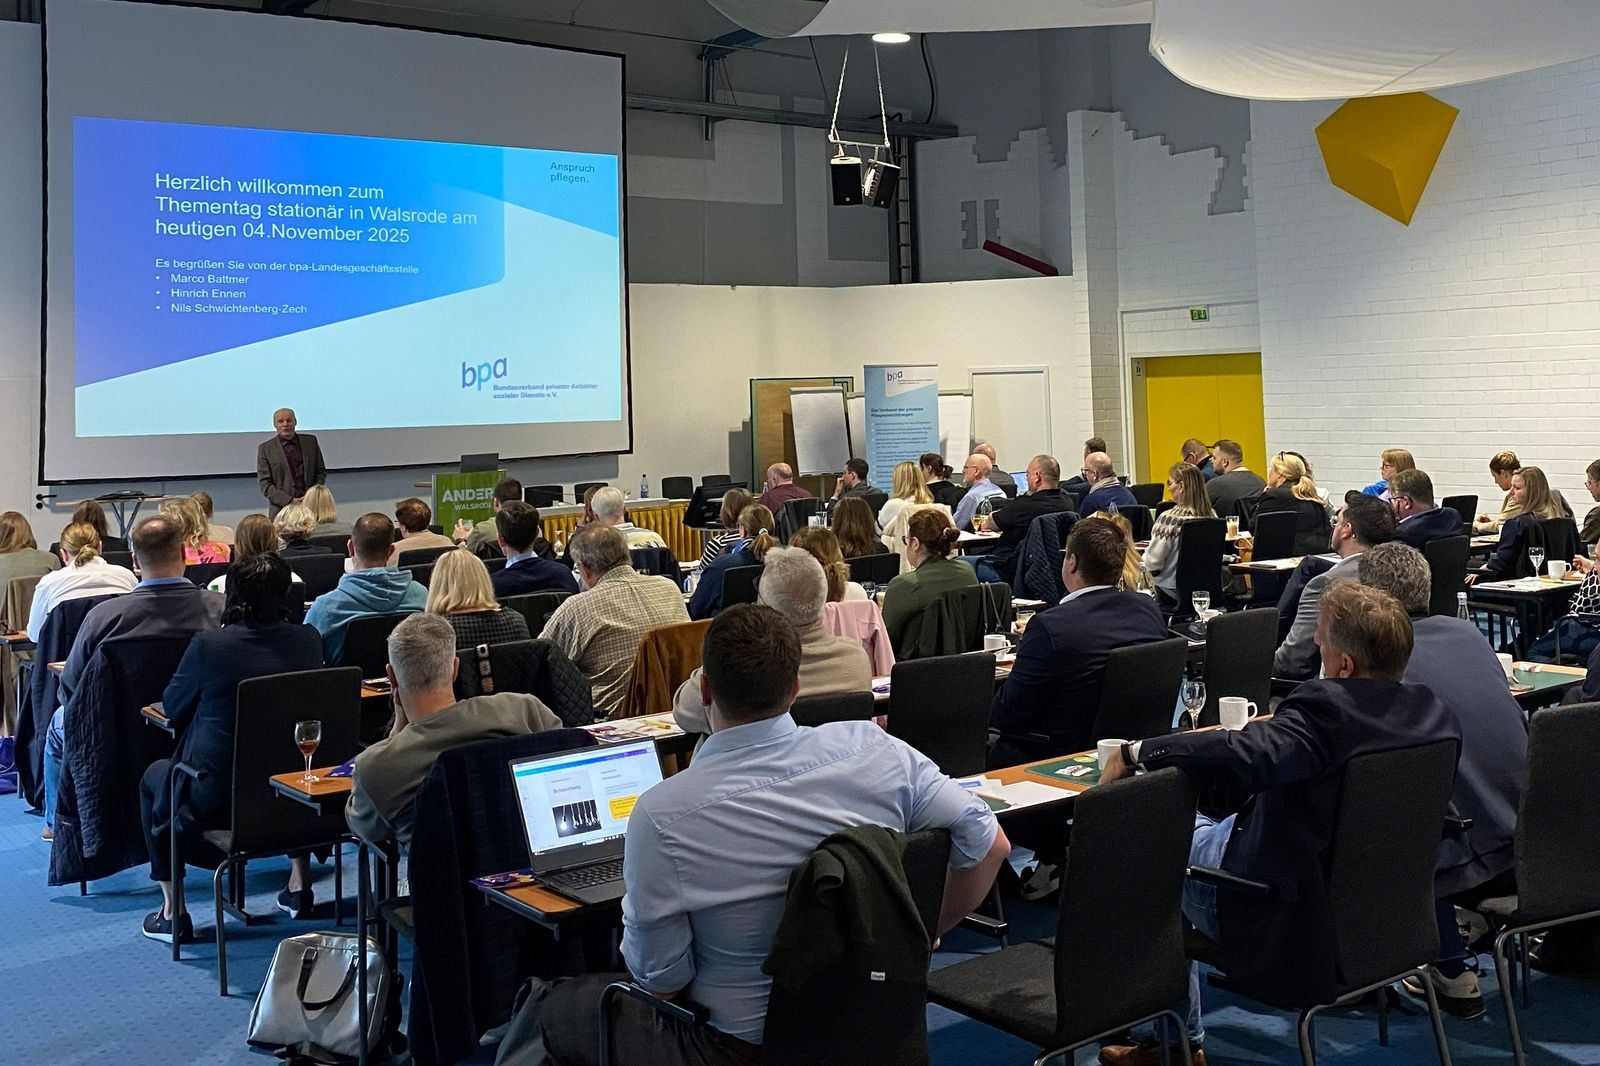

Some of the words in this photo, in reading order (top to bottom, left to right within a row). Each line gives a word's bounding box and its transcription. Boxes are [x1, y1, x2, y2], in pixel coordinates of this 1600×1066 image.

[550, 161, 595, 173] Anspruch
[550, 172, 589, 184] pflegen.
[155, 172, 232, 192] Herzlich
[237, 178, 343, 198] willkommen
[348, 186, 384, 199] zum
[155, 196, 262, 219] Thementag
[267, 203, 344, 219] stationär
[350, 205, 364, 220] in
[369, 206, 447, 224] Walsrode
[452, 213, 477, 225] am
[155, 219, 236, 240] heutigen
[243, 223, 363, 241] 04.November
[368, 227, 410, 243] 2025
[155, 259, 170, 268] Es
[173, 259, 225, 271] begrüßen
[227, 260, 245, 270] Sie
[248, 261, 267, 270] von
[269, 261, 287, 271] der
[289, 262, 420, 274] bpa-Landesgeschäftsstelle
[171, 273, 205, 283] Marco
[207, 274, 249, 284] Battmer
[171, 288, 209, 298] Hinrich
[211, 289, 246, 298] Ennen
[171, 303, 192, 312] Nils
[194, 303, 308, 315] Schwichtenberg-Zech
[461, 357, 507, 391] bpa
[887, 370, 903, 382] bpa
[520, 391, 545, 399] Dienste
[442, 487, 496, 503] ANDER
[454, 502, 492, 510] WALSRODE
